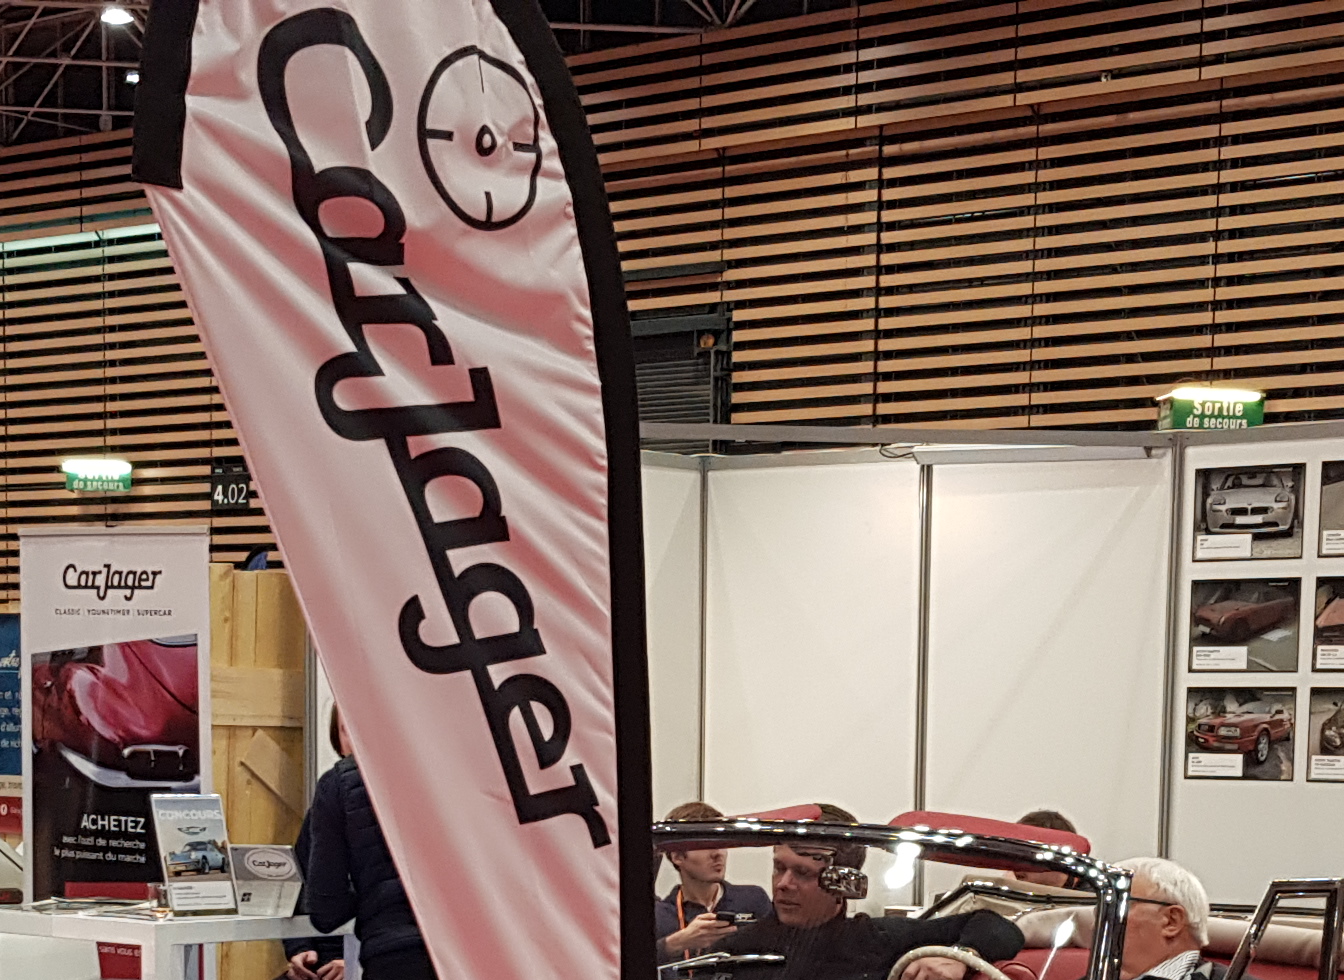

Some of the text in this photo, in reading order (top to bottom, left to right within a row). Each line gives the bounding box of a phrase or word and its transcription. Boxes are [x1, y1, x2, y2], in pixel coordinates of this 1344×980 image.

[1193, 400, 1244, 416] Sortie
[258, 6, 612, 851] CarJager
[1186, 416, 1248, 430] de secours
[213, 483, 247, 504] 4.02
[62, 563, 163, 601] CarJager
[80, 813, 146, 834] ACHETEZ
